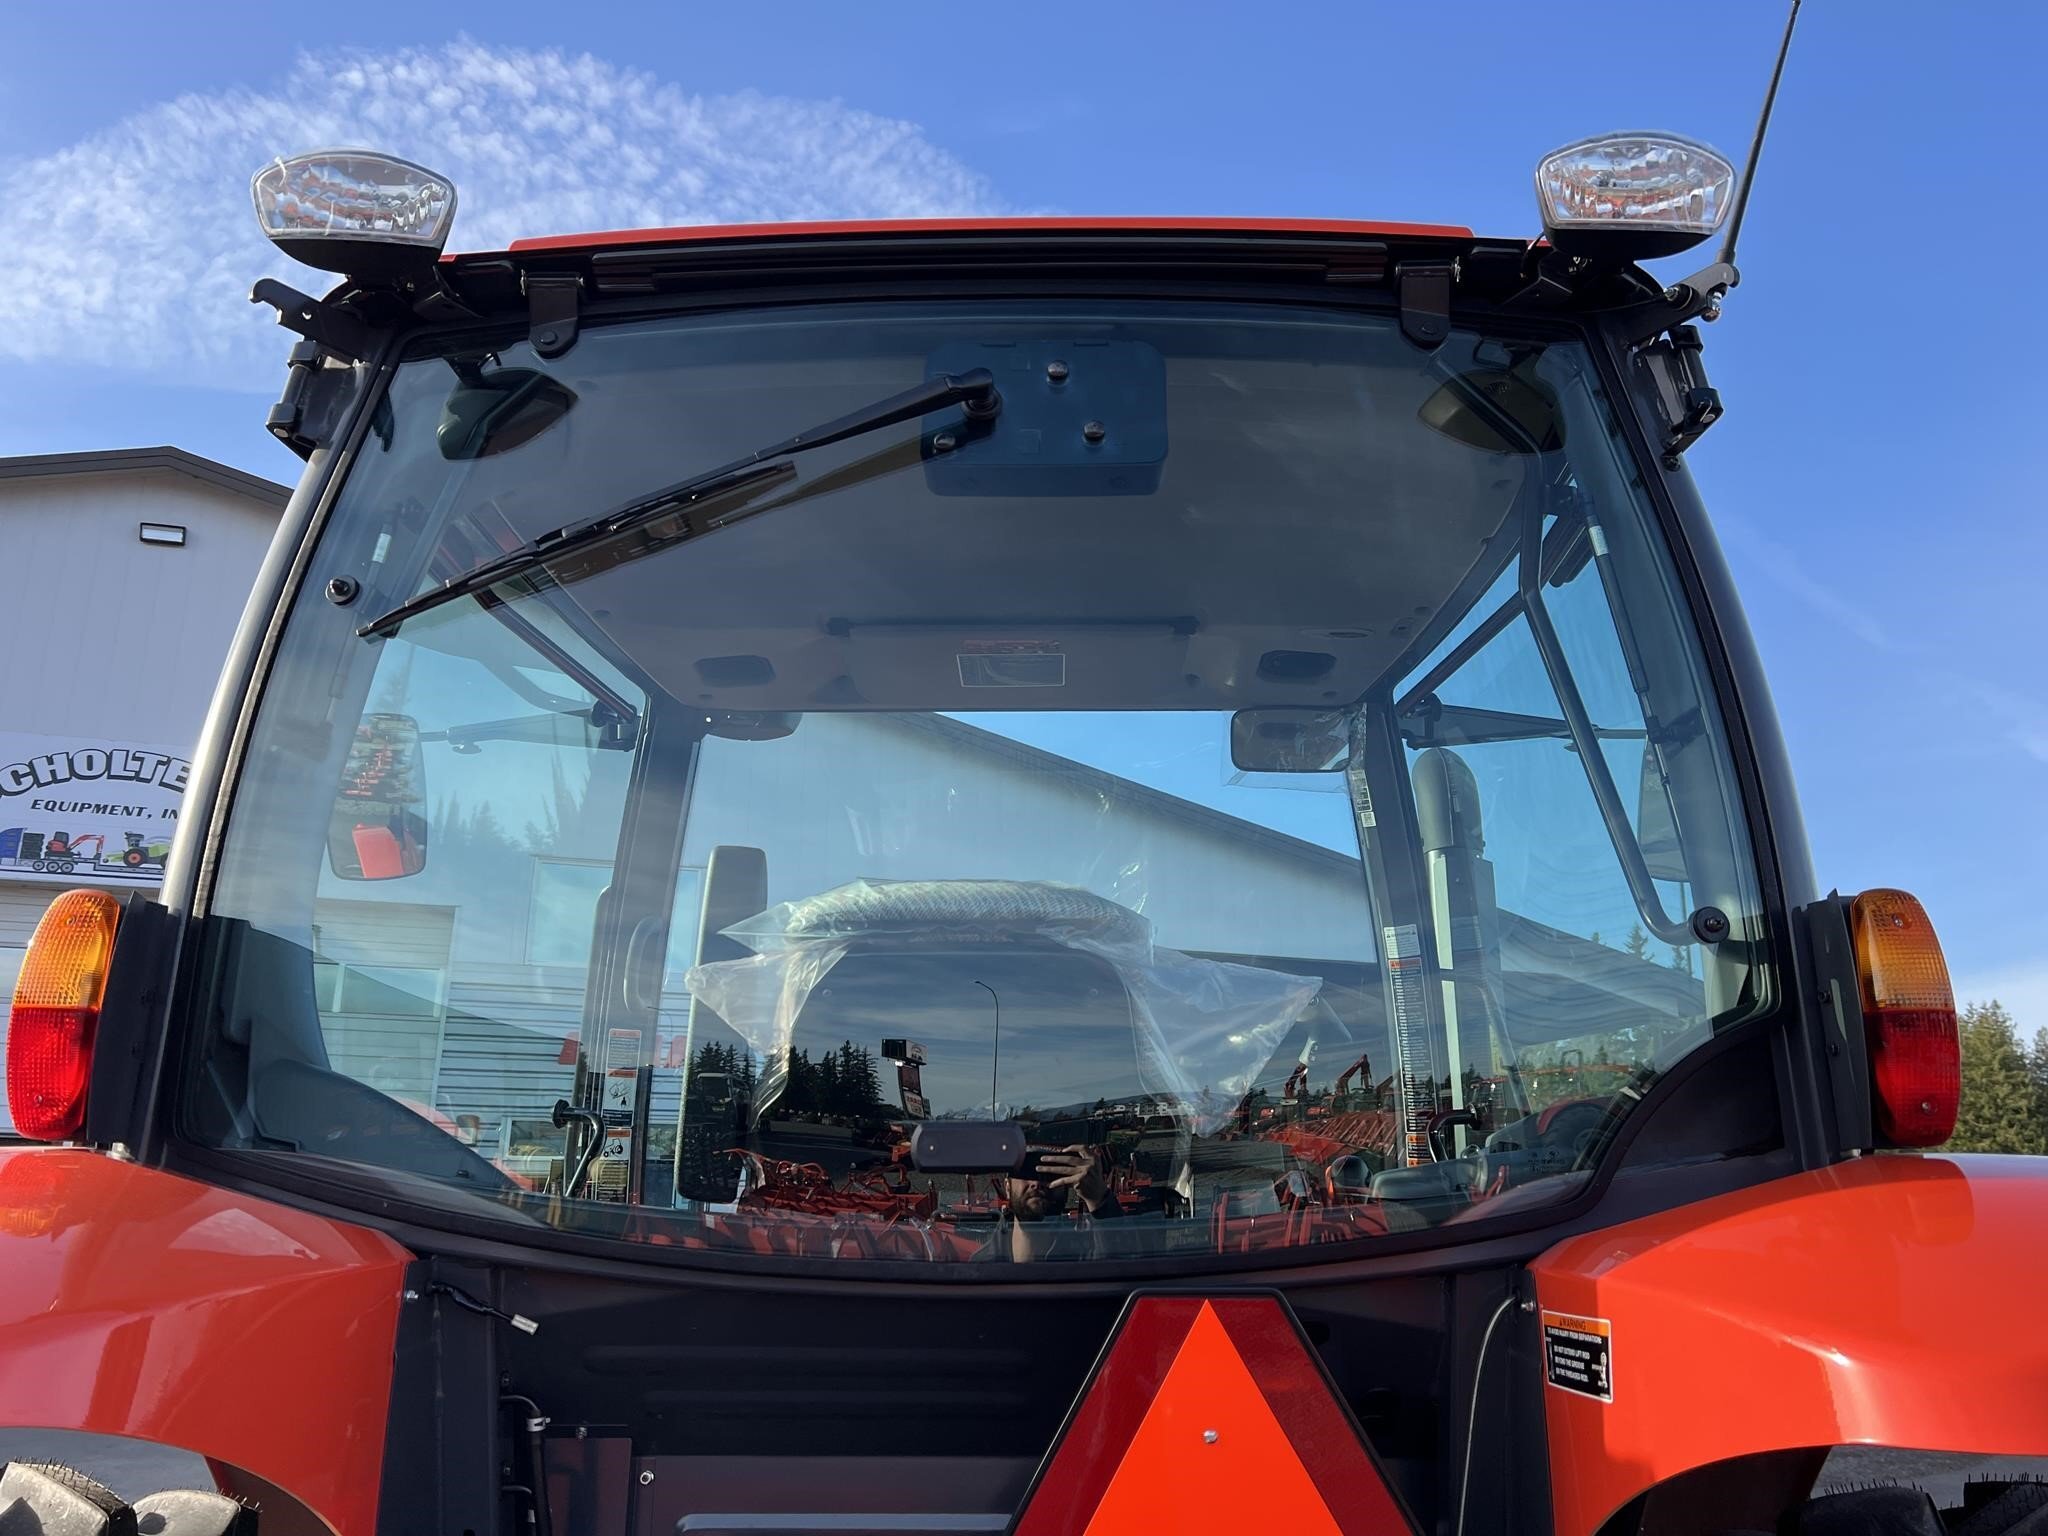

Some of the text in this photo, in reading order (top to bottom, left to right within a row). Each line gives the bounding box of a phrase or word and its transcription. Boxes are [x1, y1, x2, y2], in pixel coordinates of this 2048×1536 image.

[0, 749, 193, 796] CHOLTE
[31, 799, 153, 819] EQUIPMENT,
[1563, 1318, 1586, 1331] WARNING
